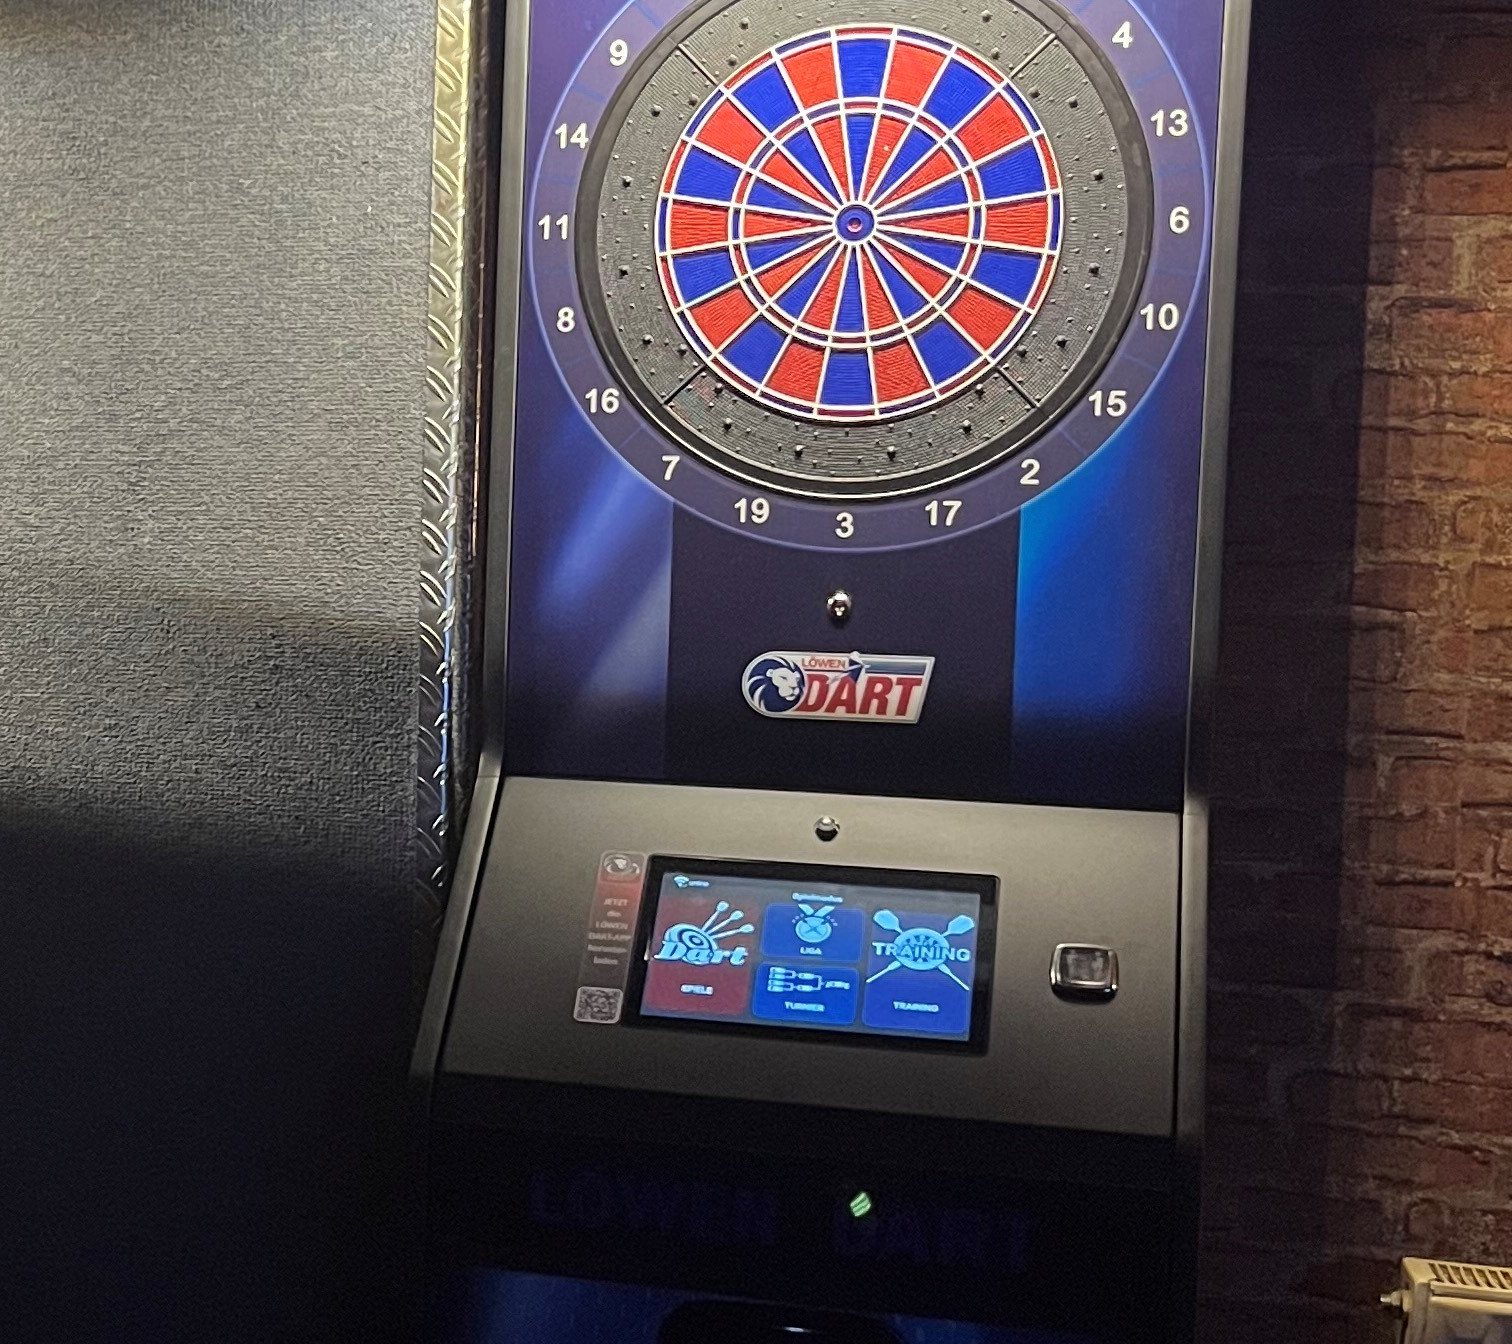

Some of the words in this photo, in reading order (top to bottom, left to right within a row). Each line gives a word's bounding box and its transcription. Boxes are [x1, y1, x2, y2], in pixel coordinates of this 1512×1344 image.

[1111, 20, 1134, 49] 4
[609, 38, 629, 67] 9
[554, 122, 590, 149] 14
[1150, 108, 1189, 137] 13
[538, 214, 569, 240] 11
[1169, 206, 1190, 234] 6
[556, 306, 576, 333] 8
[1140, 302, 1180, 331] 10
[585, 387, 620, 414] 16
[1088, 390, 1127, 417] 15
[661, 455, 681, 481] 7
[1019, 458, 1040, 486] 2
[734, 497, 770, 524] 19
[924, 500, 963, 526] 17
[835, 511, 854, 538] 3
[800, 656, 847, 669] LÖWEN
[795, 673, 923, 716] DART
[654, 939, 750, 967] Dart
[872, 941, 972, 962] TRAINING
